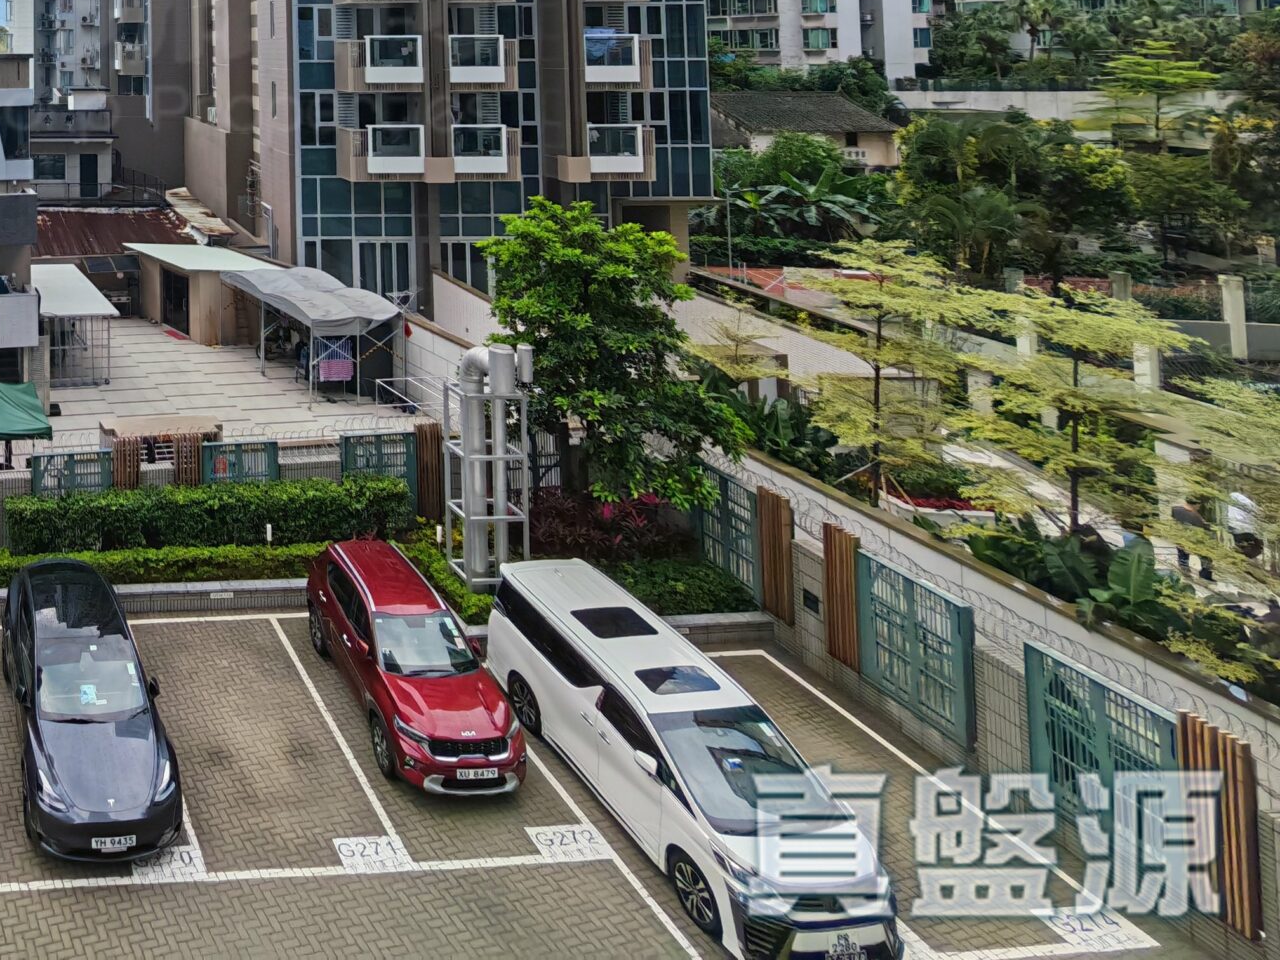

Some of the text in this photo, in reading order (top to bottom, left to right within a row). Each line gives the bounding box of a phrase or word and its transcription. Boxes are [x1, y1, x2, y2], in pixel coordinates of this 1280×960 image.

[458, 769, 496, 778] XU 8479
[94, 836, 134, 848] YH 9435
[535, 829, 600, 847] G272
[338, 841, 397, 858] G271
